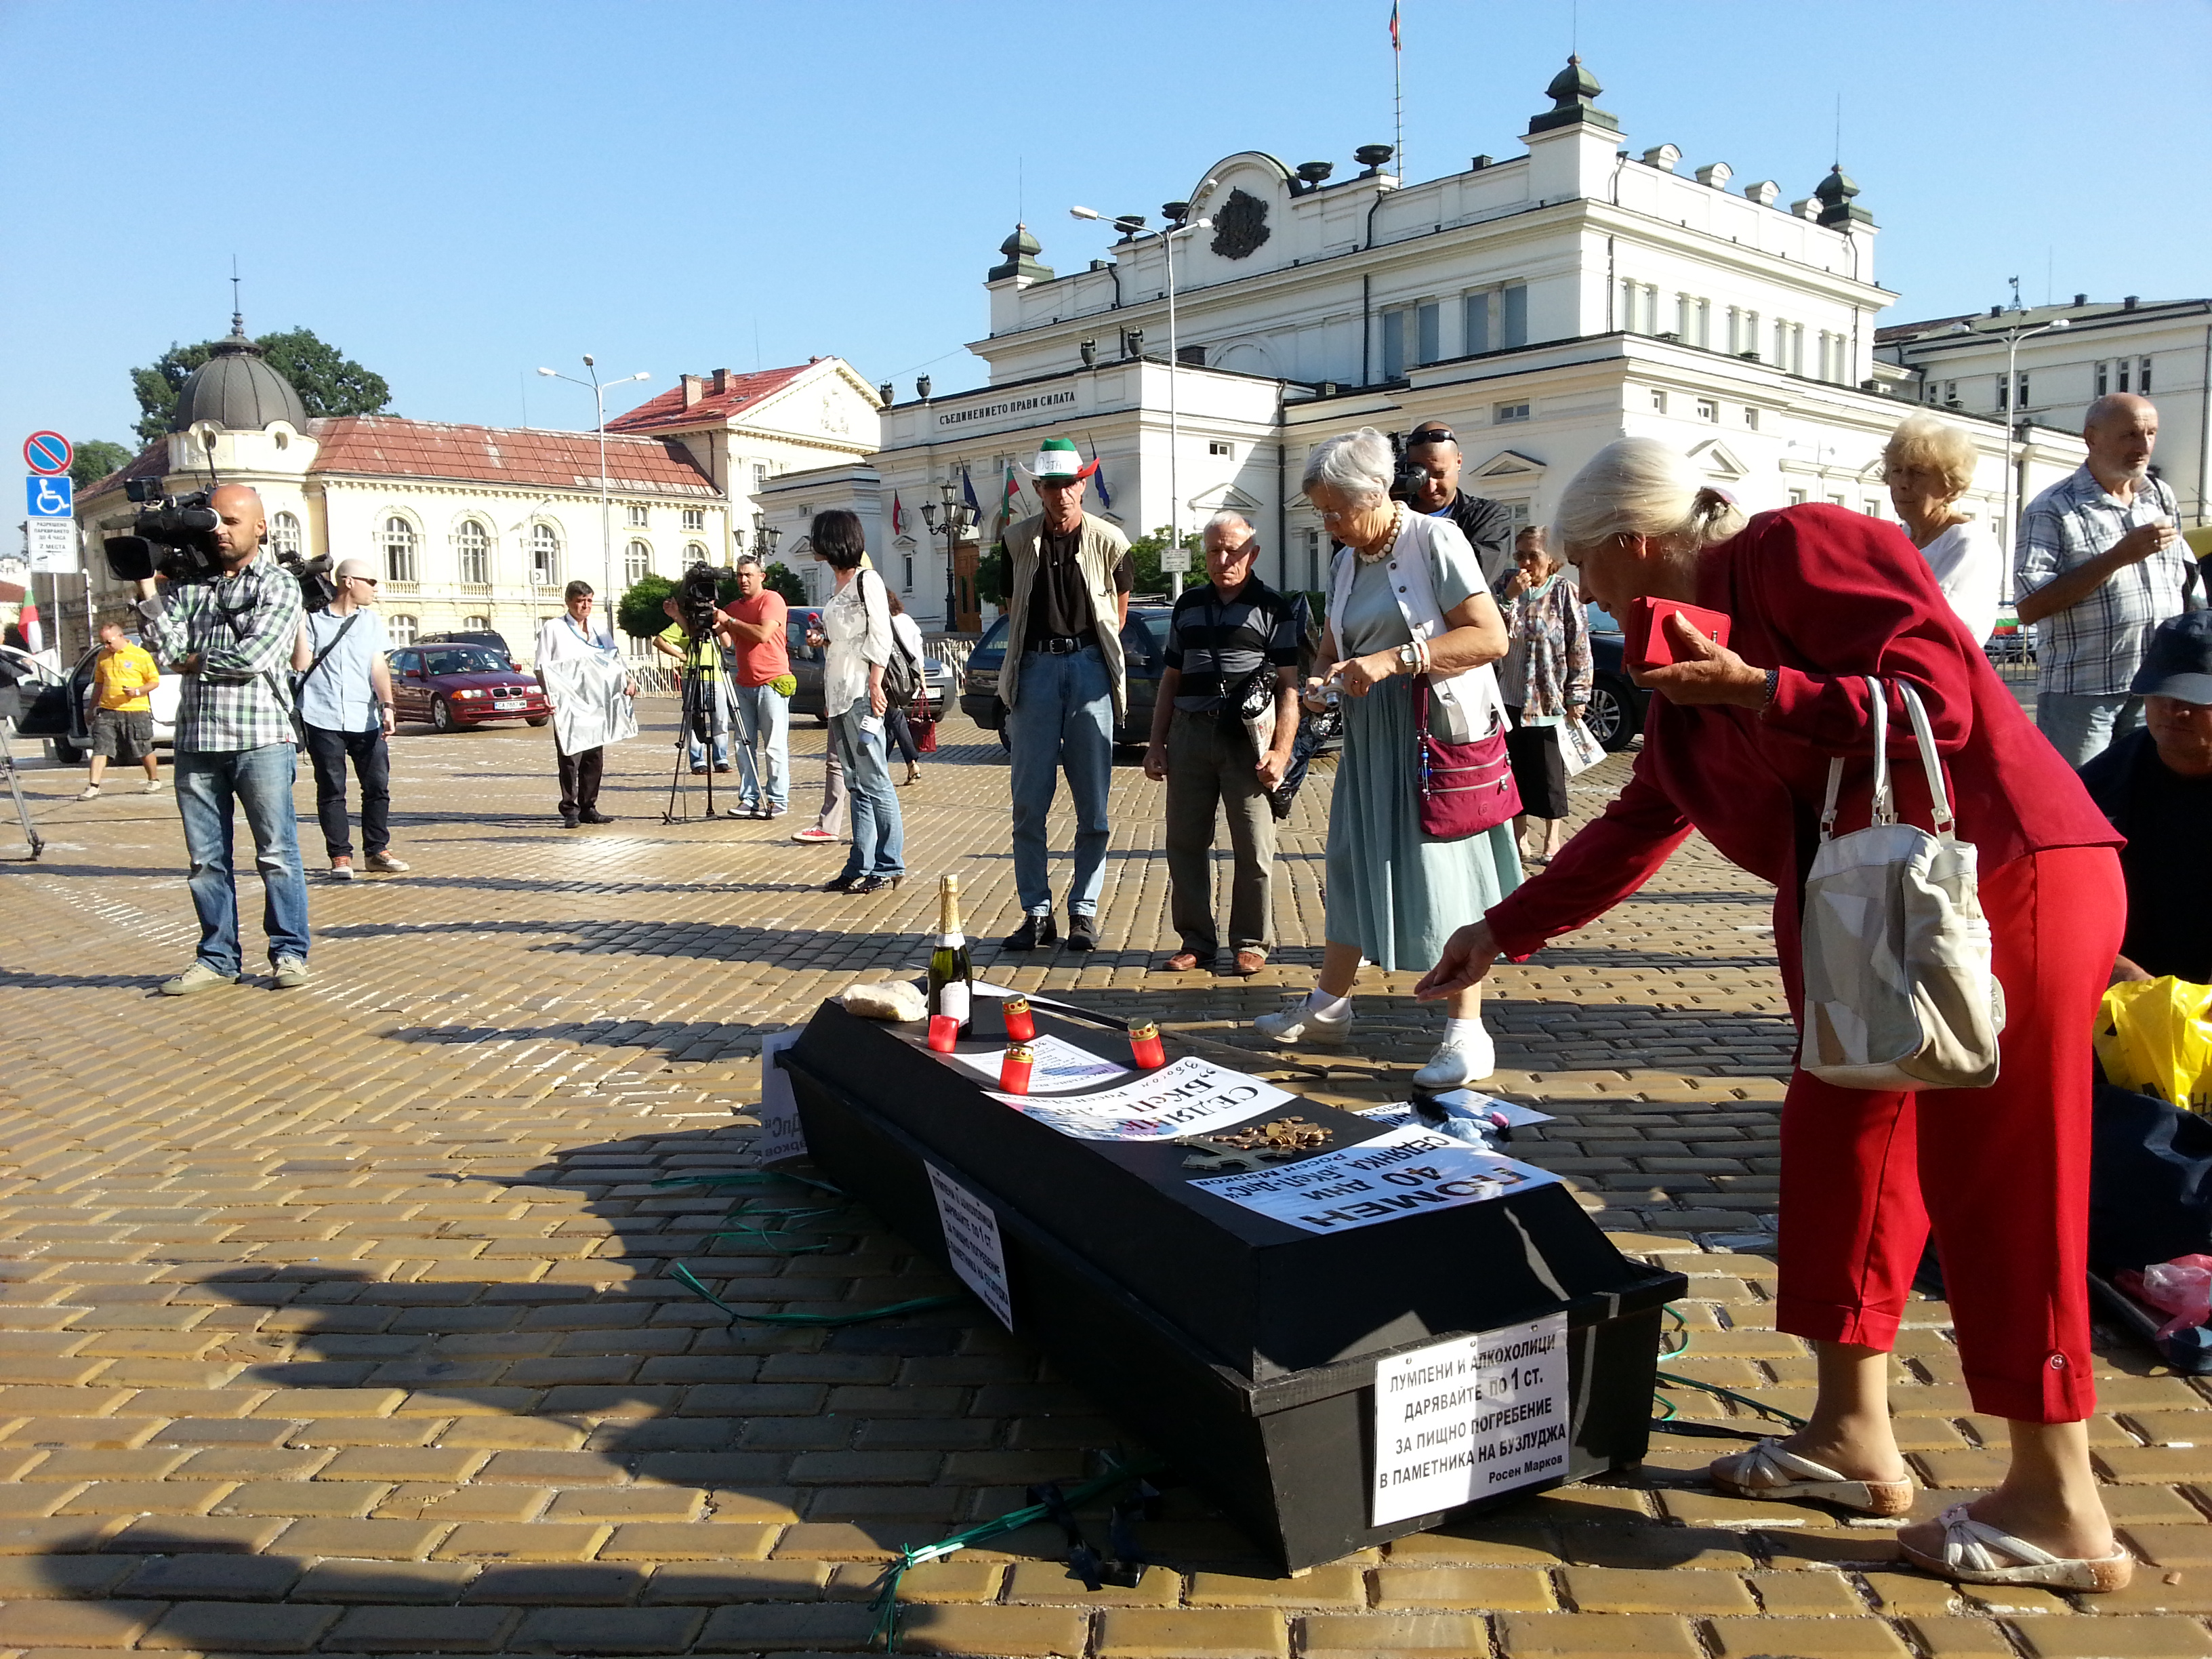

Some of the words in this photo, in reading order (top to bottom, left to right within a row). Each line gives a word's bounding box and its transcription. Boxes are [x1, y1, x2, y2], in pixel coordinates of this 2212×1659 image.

[940, 404, 1008, 425] СЪЕДИНЕНИЕТО
[1011, 398, 1038, 412] ПРАВИ
[1041, 391, 1075, 407] СИЛАТА
[1290, 1153, 1348, 1173] Росен
[1353, 1135, 1451, 1172] СЕДЯНКА
[1195, 1166, 1288, 1187] Марков
[1300, 1179, 1375, 1201] ДНИ
[1381, 1166, 1442, 1186] 40
[1298, 1167, 1532, 1227] ПОМЕН
[1389, 1361, 1454, 1393] ЛУМПЕНИ
[1457, 1358, 1466, 1374] И
[1470, 1334, 1556, 1372] АЛКОХОЛИЦИ
[1404, 1385, 1482, 1422] ДАРЯВАЙТЕ
[1490, 1376, 1507, 1396] ПО
[1511, 1367, 1519, 1390] 1
[1523, 1368, 1544, 1387] СТ.
[1395, 1437, 1412, 1455] ЗА
[1417, 1422, 1466, 1450] ПИЩНО
[1471, 1397, 1553, 1435] ПОГРЕБЕНИЕ
[1380, 1473, 1388, 1489] В
[1393, 1450, 1475, 1486] ПАМЕТНИКА
[1478, 1443, 1496, 1463] НА
[1499, 1422, 1567, 1457] БУЗЛУДЖА
[1488, 1466, 1521, 1483] Росен
[1523, 1454, 1563, 1476] Марков
